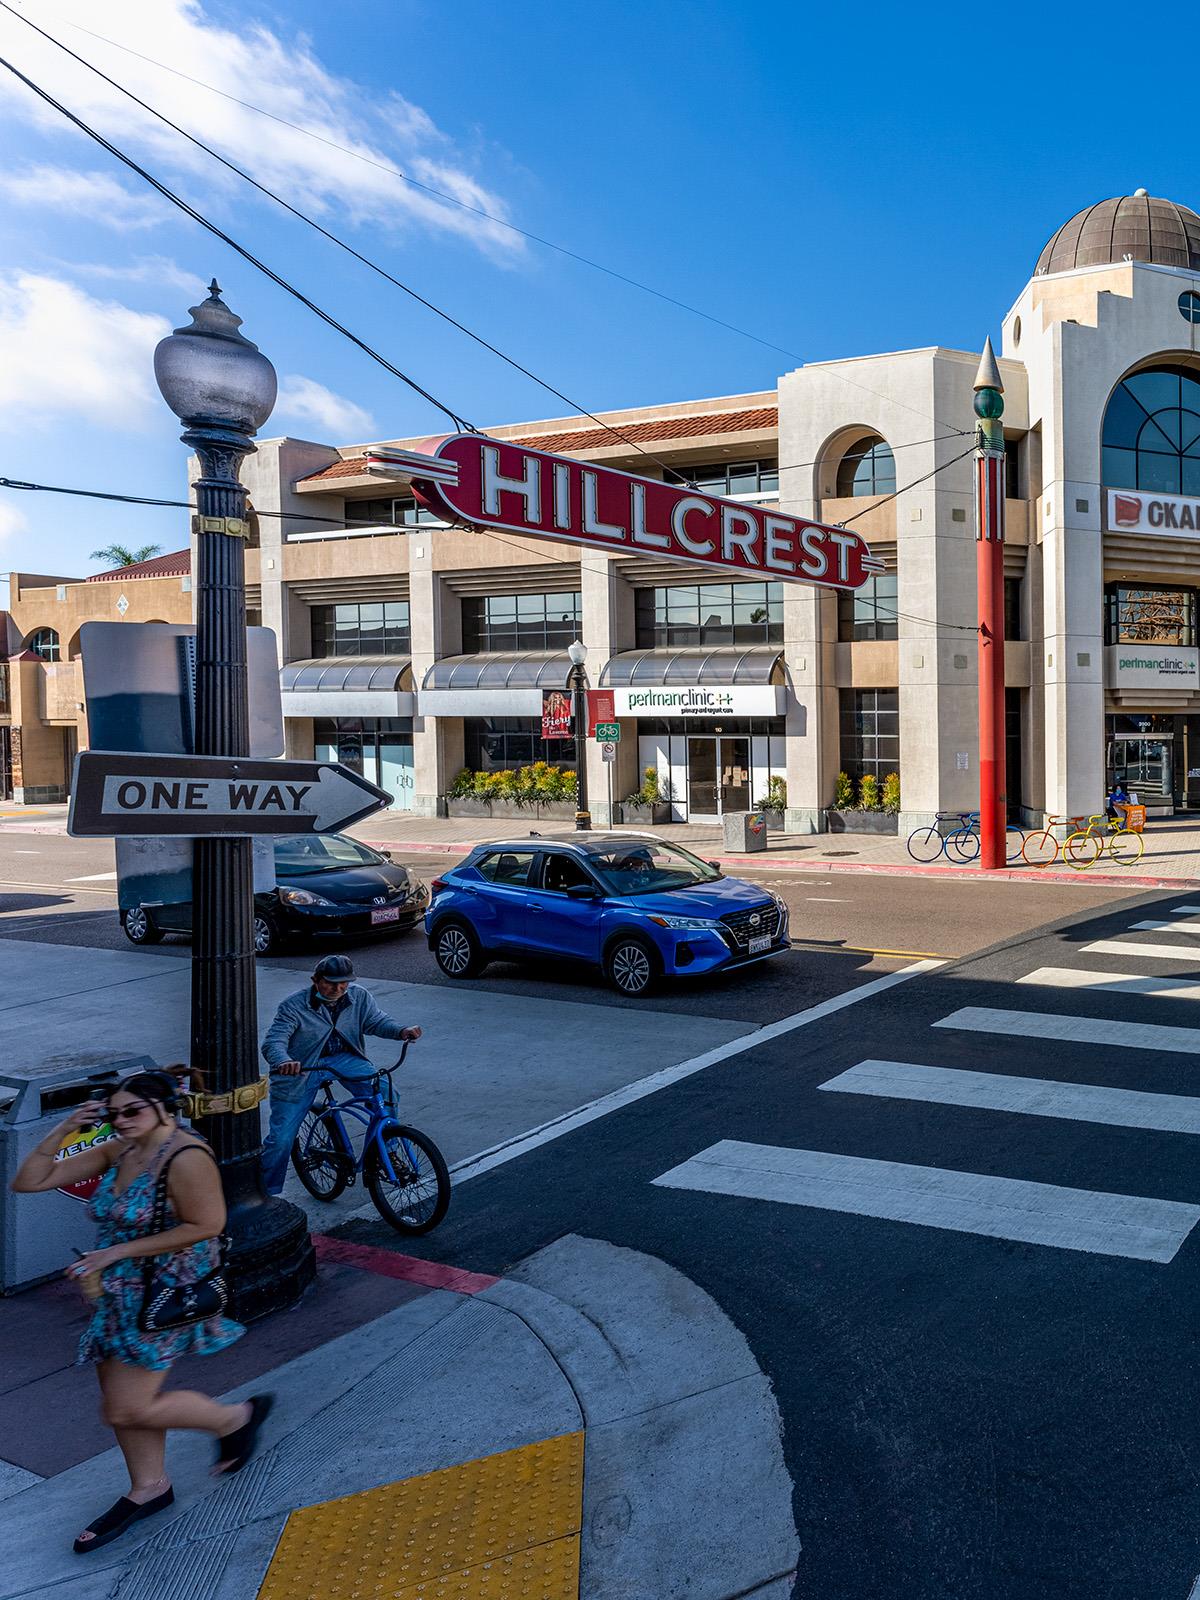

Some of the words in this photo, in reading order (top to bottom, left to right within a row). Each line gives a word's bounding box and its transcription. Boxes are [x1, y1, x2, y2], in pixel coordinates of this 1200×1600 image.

[481, 445, 859, 583] HILLCREST
[542, 715, 571, 728] Fiery
[117, 781, 209, 809] ONE
[228, 784, 311, 811] WAY
